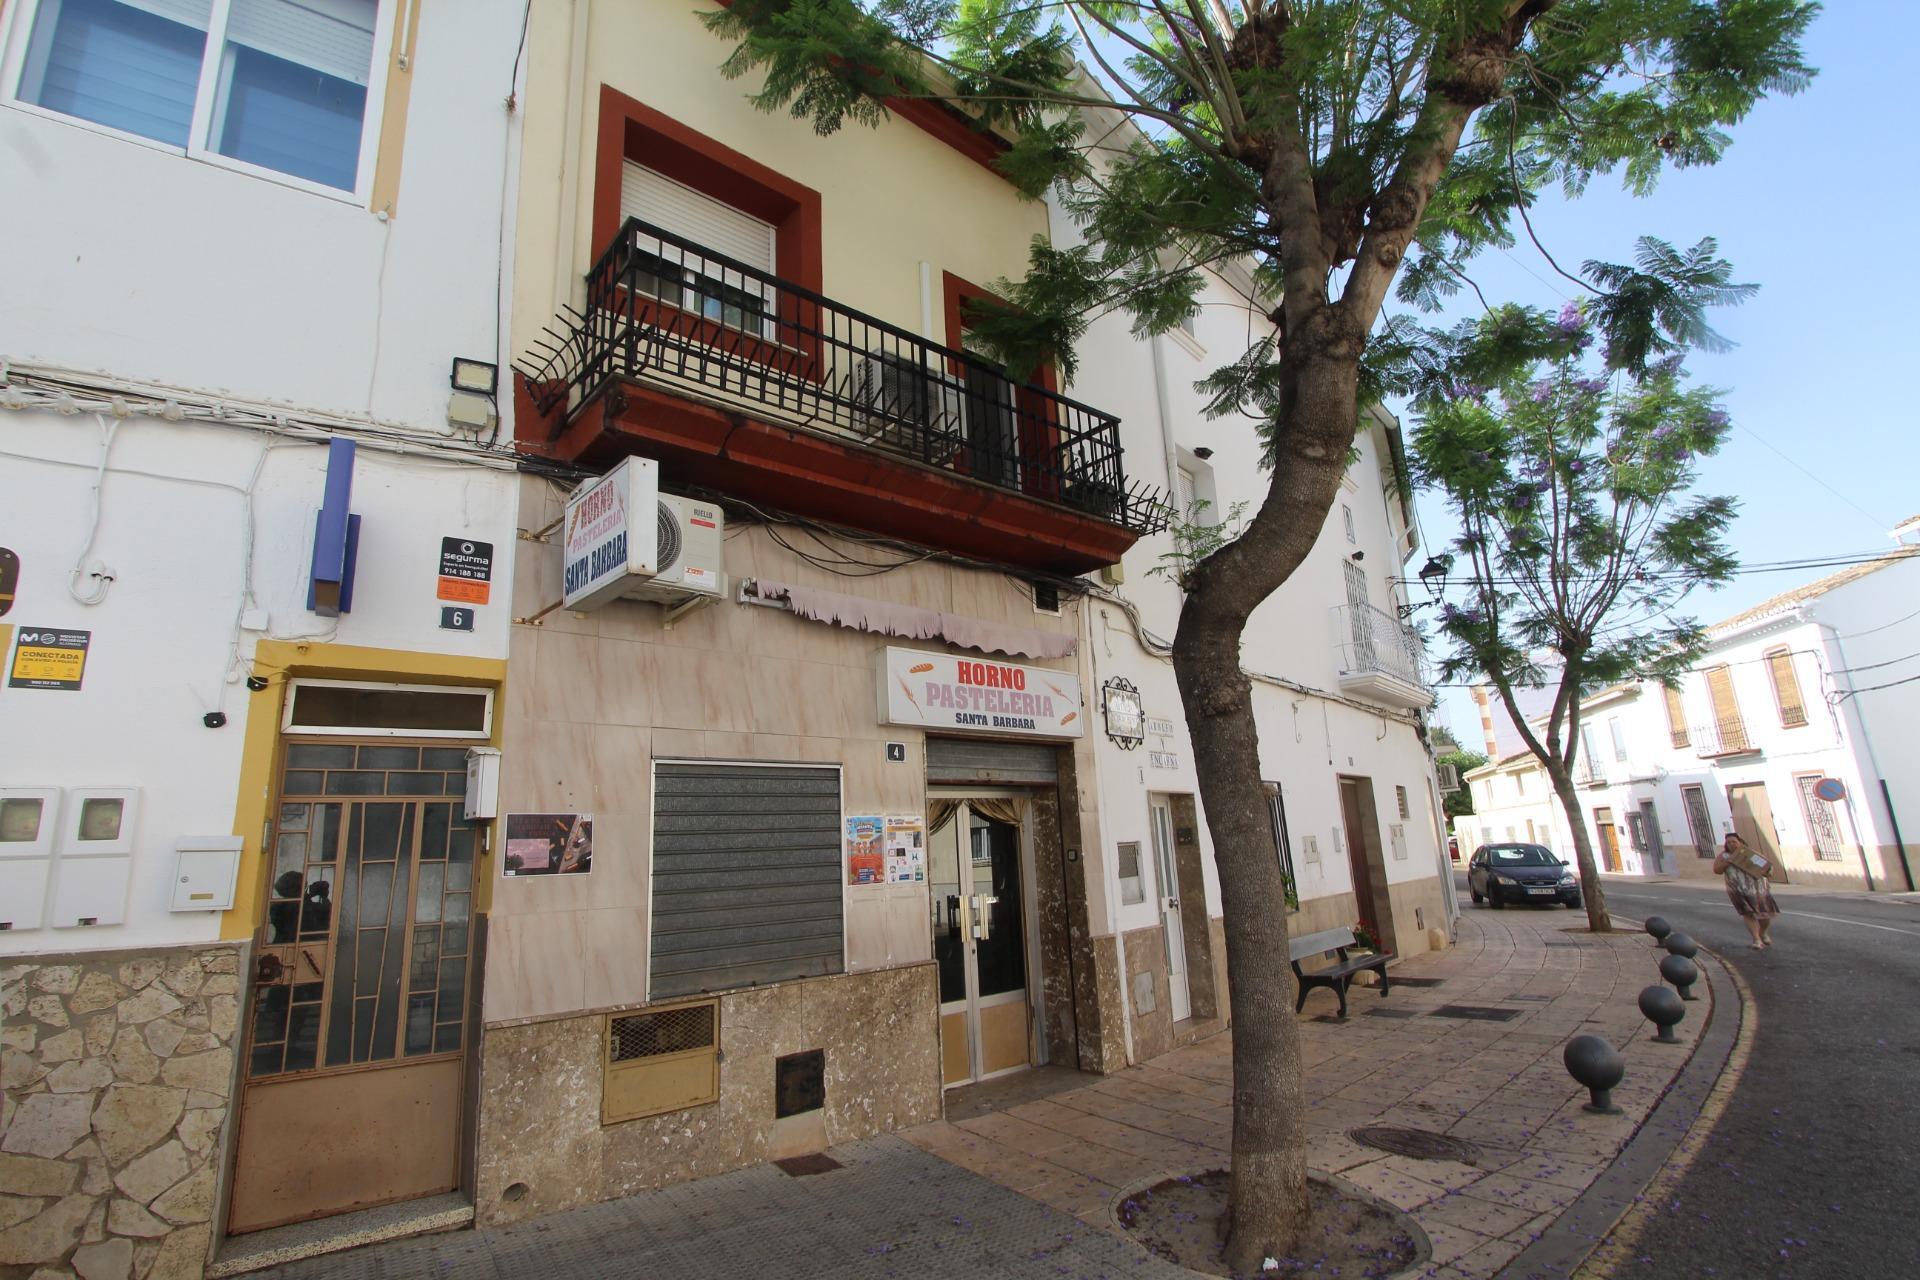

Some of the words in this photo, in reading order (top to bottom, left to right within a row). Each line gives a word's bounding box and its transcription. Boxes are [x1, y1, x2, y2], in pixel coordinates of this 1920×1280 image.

[581, 480, 614, 529] HORNO
[573, 510, 622, 554] PASTELERIA
[444, 553, 489, 565] segurma
[565, 555, 589, 596] SANTA
[591, 530, 628, 581] BARBARA
[444, 567, 457, 575] 914
[453, 611, 463, 626] 6
[22, 651, 80, 660] CONECTADA
[957, 660, 1026, 691] HORNO
[925, 682, 1055, 718] PASTELERIA
[955, 712, 988, 727] SANTA
[993, 715, 1036, 730] BARBARA
[893, 747, 899, 759] 4
